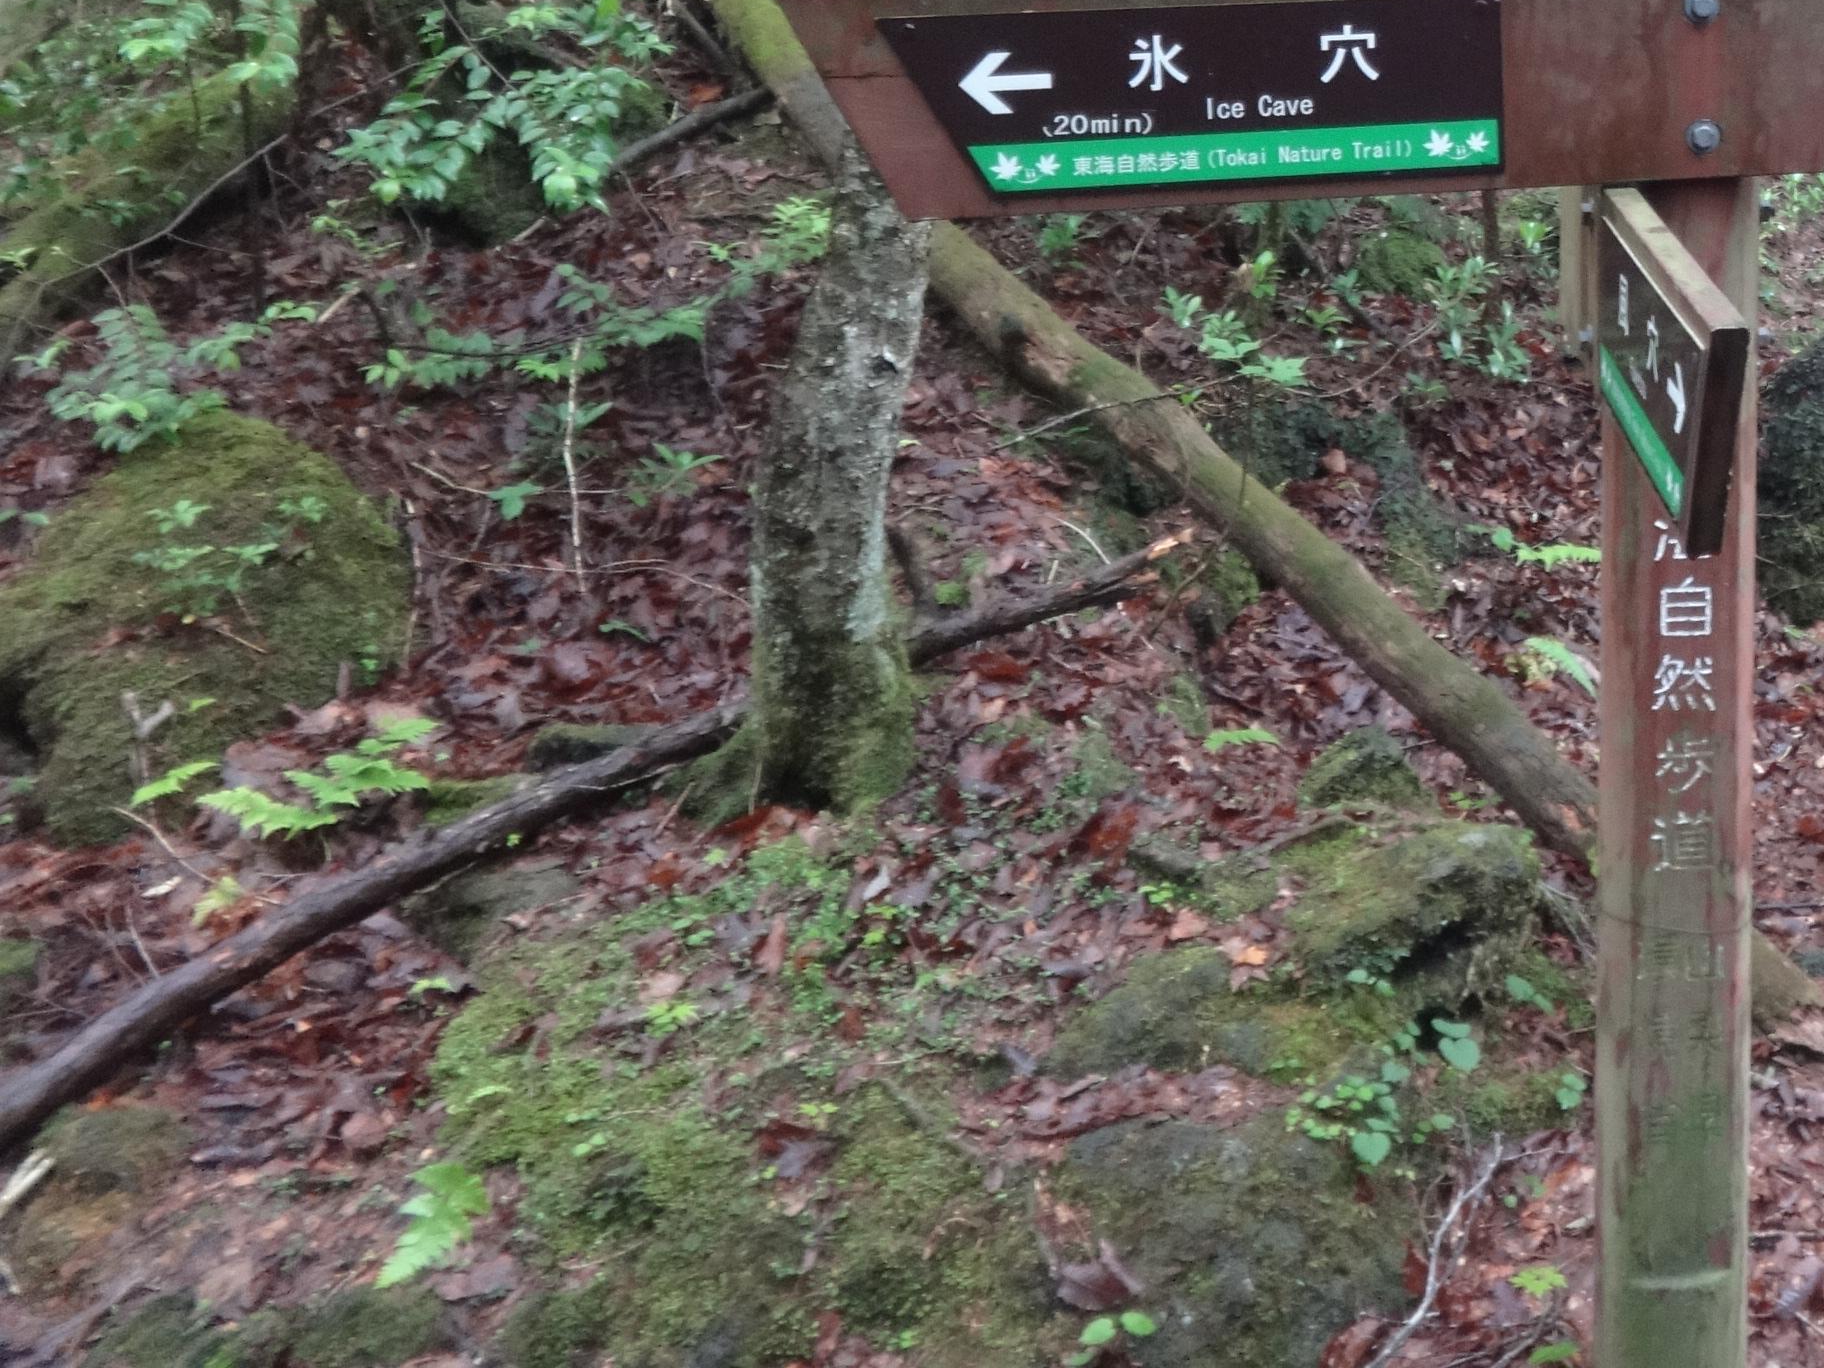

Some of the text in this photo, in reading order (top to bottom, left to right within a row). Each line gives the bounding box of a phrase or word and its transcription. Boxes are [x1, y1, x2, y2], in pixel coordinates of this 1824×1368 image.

[1128, 24, 1381, 92] 氷穴
[1205, 94, 1315, 120] Ice Cave
[1072, 140, 1413, 177] 東海自然歩道 (Tokai Nature Trail)
